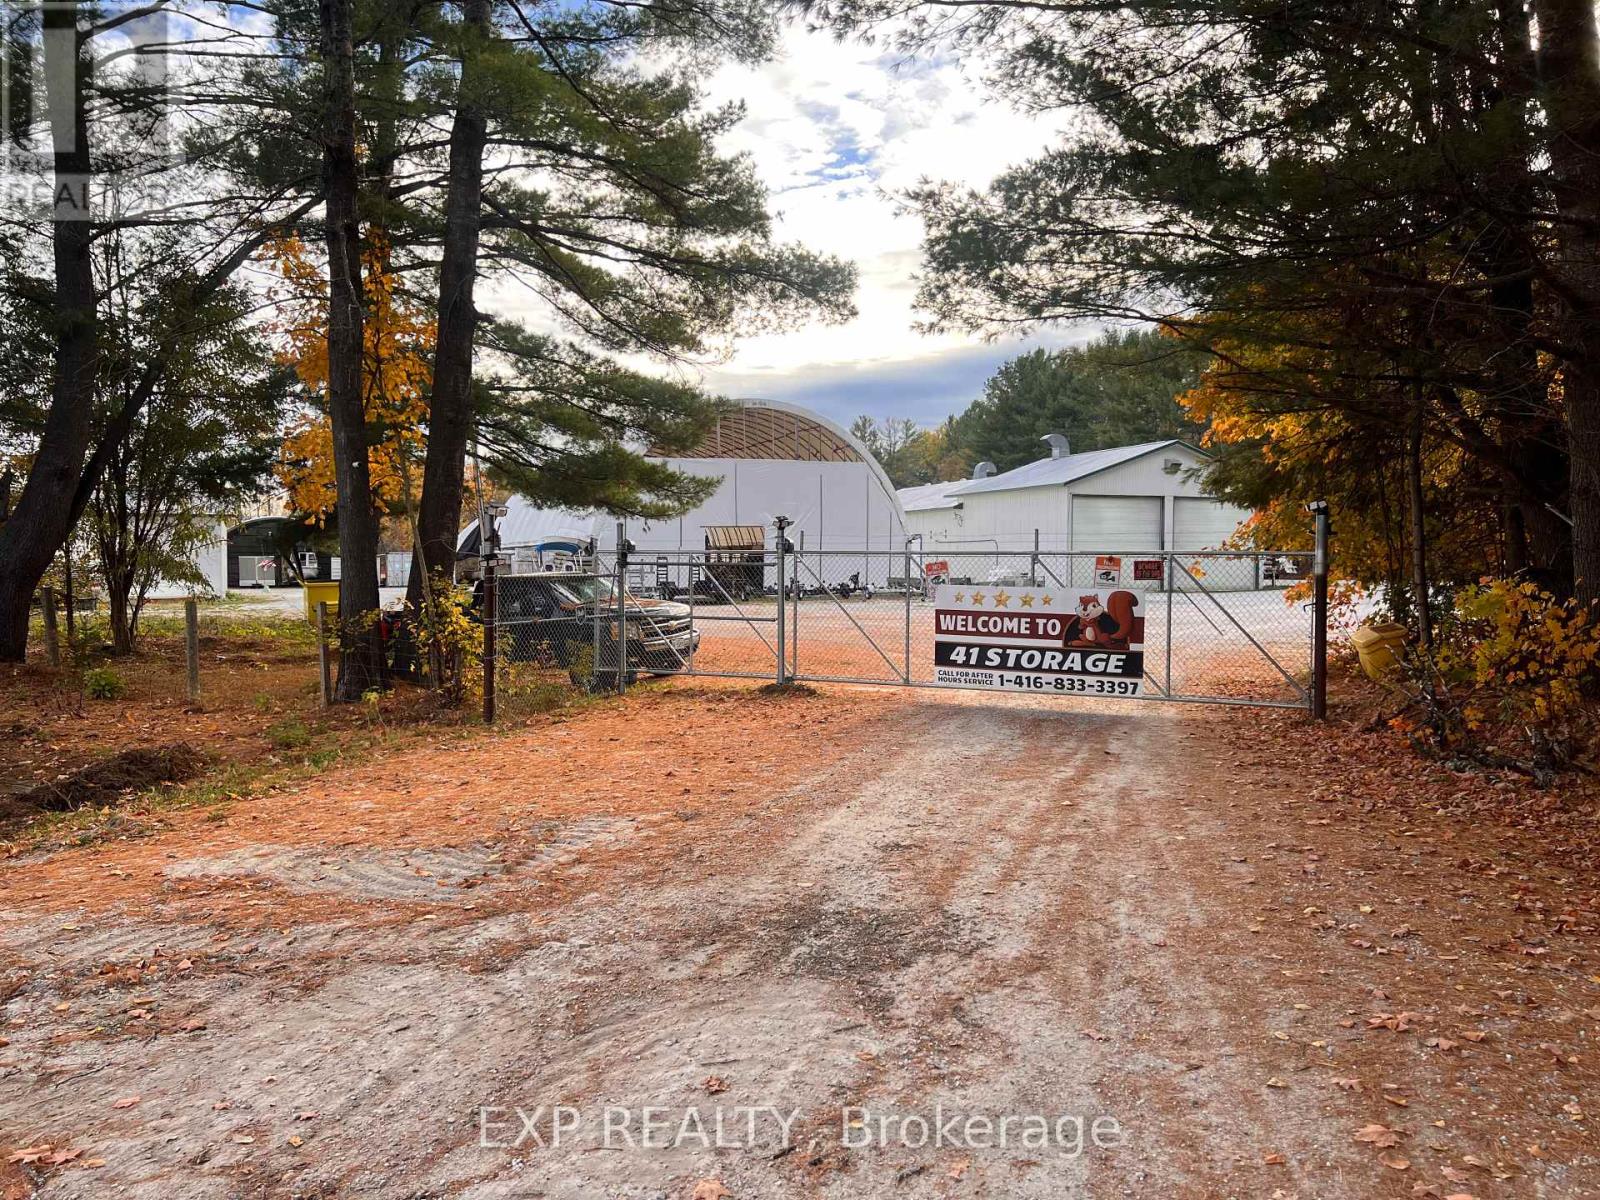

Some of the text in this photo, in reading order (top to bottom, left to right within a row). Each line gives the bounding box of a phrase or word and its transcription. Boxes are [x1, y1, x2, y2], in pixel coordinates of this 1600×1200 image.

[939, 614, 1062, 636] WELCOME TO
[949, 646, 1127, 674] 41 STORAGE
[998, 674, 1139, 695] 1-416-833-3397
